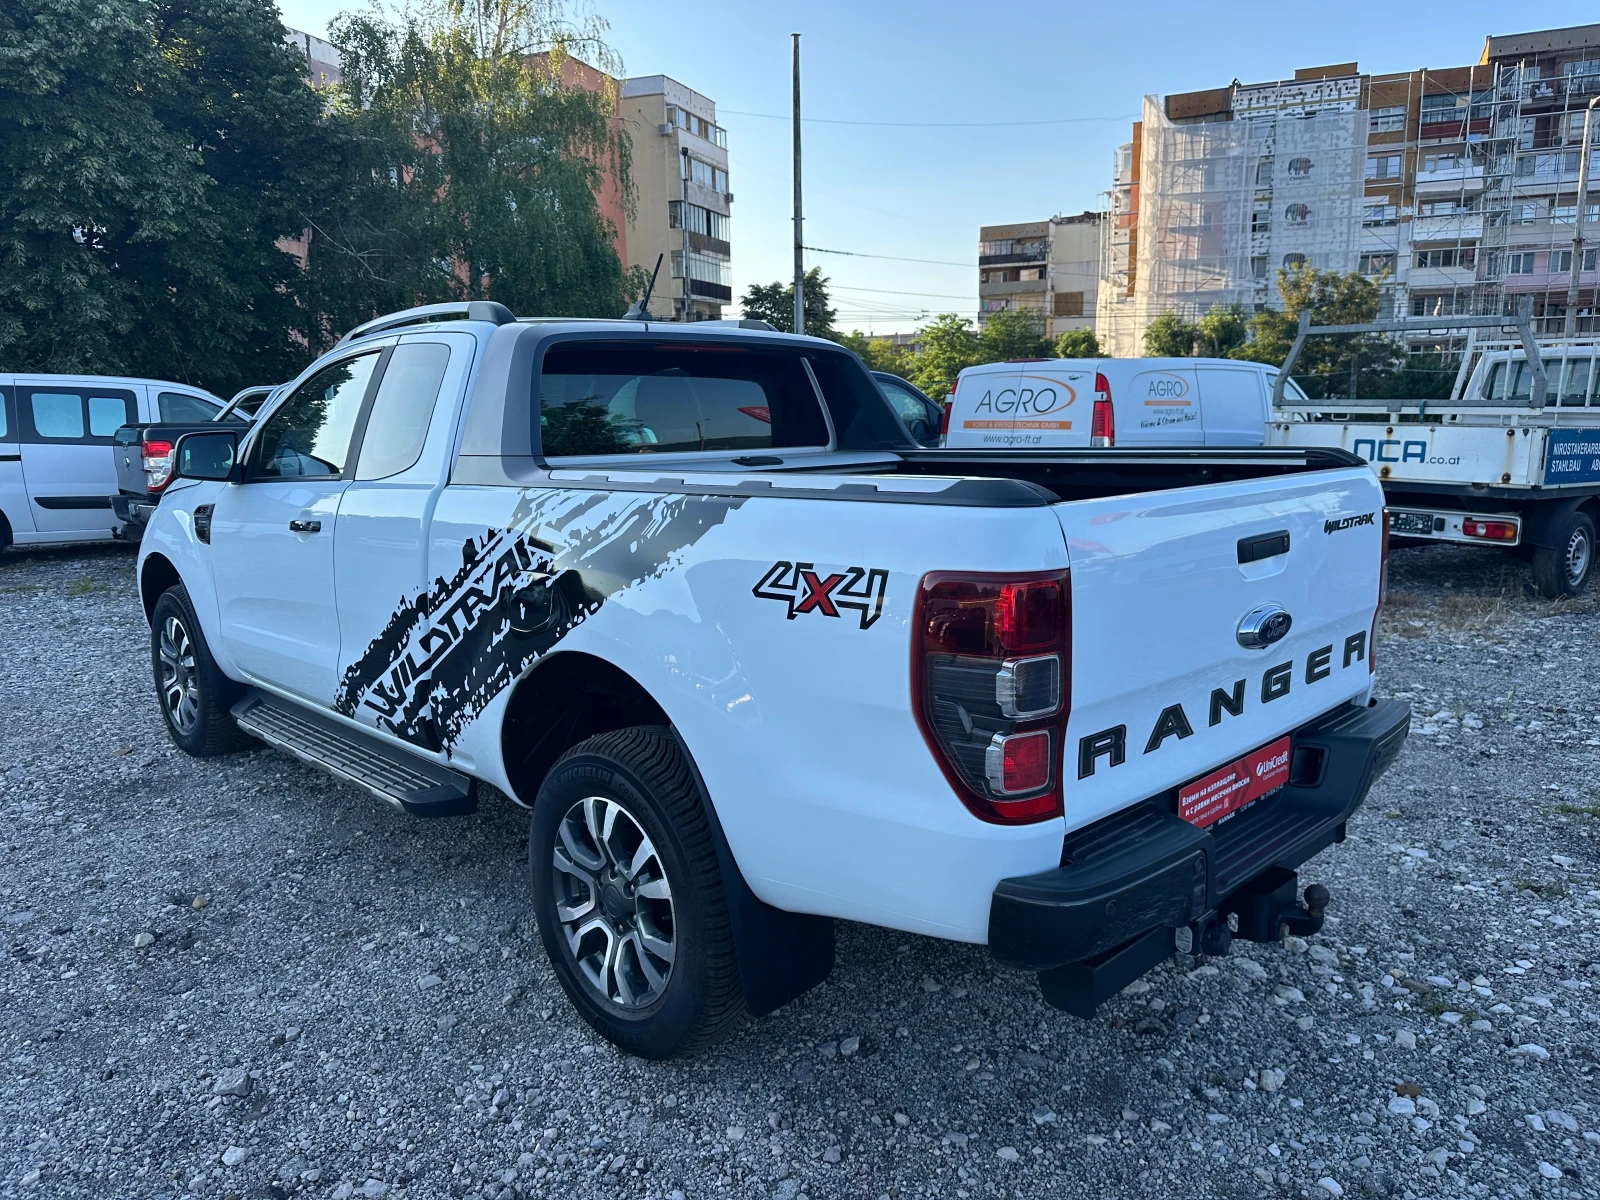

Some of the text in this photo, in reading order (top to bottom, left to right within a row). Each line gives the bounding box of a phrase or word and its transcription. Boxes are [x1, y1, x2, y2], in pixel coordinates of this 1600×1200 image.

[1148, 381, 1183, 396] AGRO
[974, 388, 1057, 413] AGRO
[983, 435, 1042, 446] www.agro-ft.at
[1551, 459, 1581, 473] STAHLBAU
[1323, 511, 1375, 535] WILDTRAK
[1266, 616, 1288, 639] Ford
[1077, 629, 1367, 781] RANGER
[1263, 750, 1288, 773] UniCredit
[560, 766, 613, 783] MICHELIN
[1182, 772, 1236, 806] Вземи на изплащане
[1185, 809, 1190, 817] и
[1194, 798, 1210, 814] равни
[1211, 786, 1231, 803] месечни
[1232, 777, 1250, 791] вноски
[619, 782, 668, 850] CROSSCLIMATE
